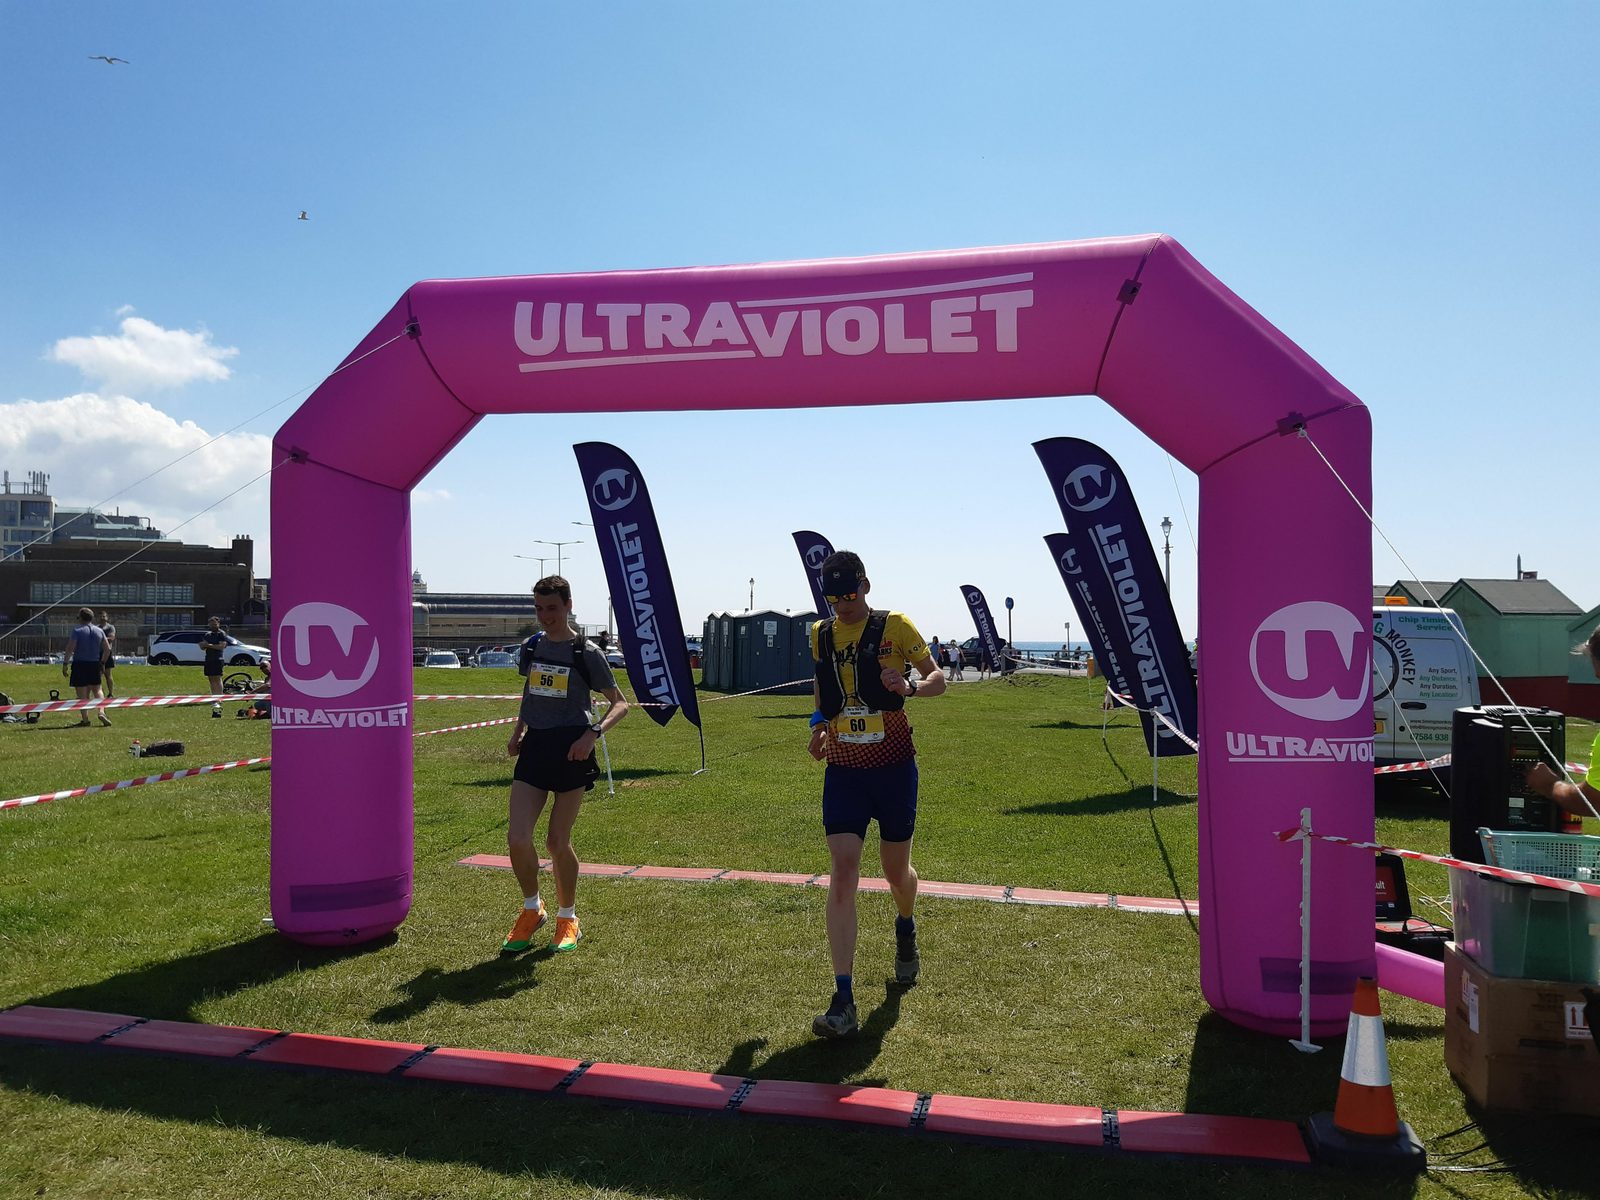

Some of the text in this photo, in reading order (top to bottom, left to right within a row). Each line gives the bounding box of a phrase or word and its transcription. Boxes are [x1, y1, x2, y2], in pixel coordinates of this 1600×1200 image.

[514, 289, 1034, 357] ULTRAVIOLET
[1095, 524, 1178, 738] ULTRAVIOLET
[1398, 616, 1419, 624] Chip
[1386, 628, 1416, 685] MONKEY
[540, 674, 554, 687] 56
[271, 705, 408, 728] ULTRAVIOLET
[850, 718, 866, 732] 60
